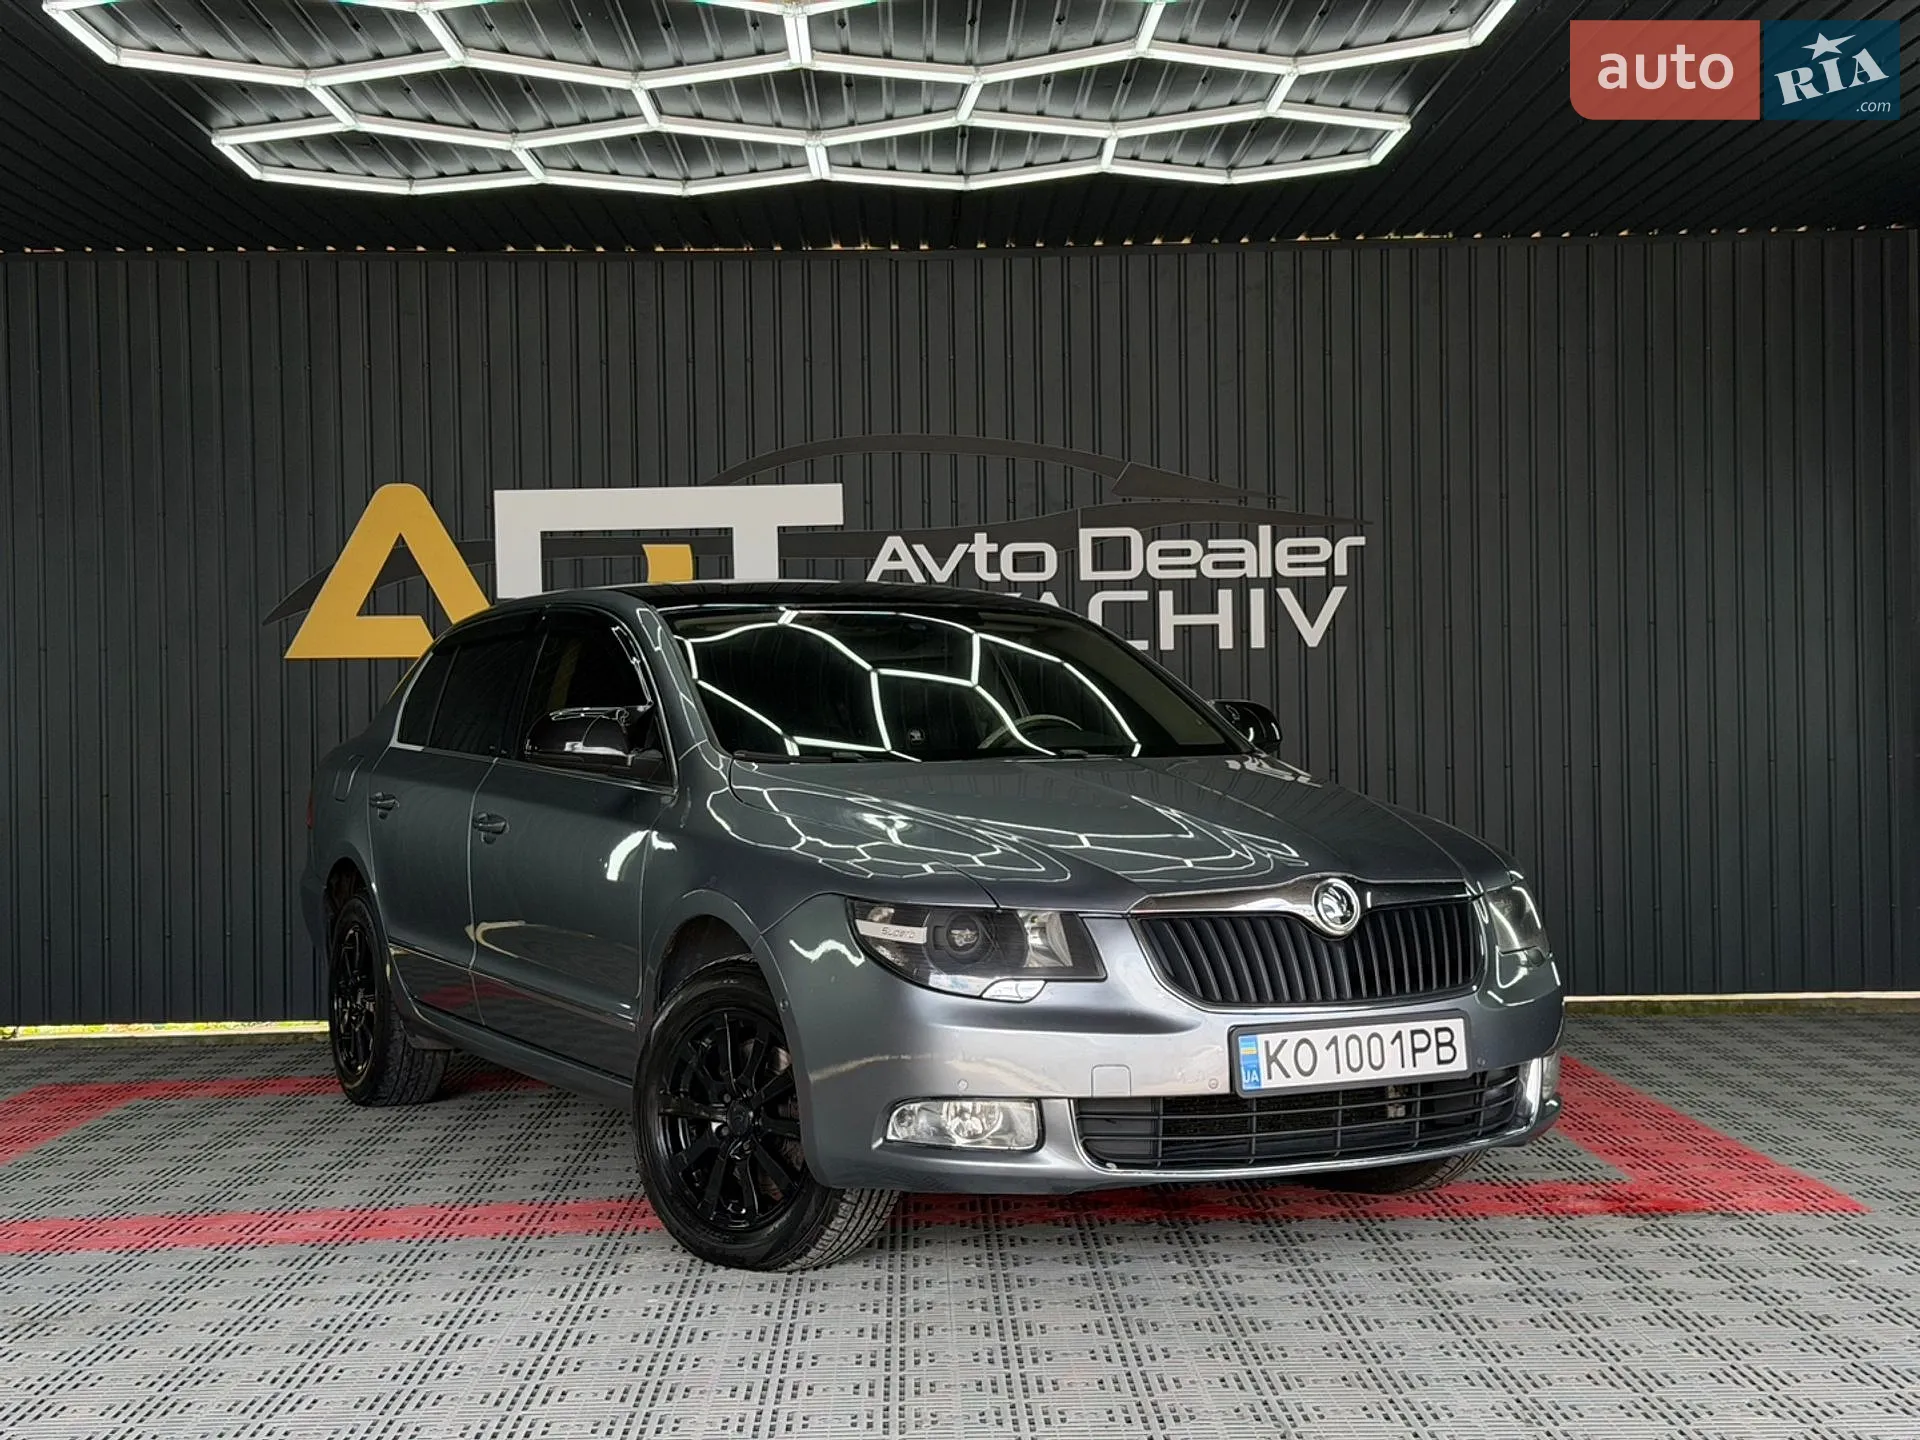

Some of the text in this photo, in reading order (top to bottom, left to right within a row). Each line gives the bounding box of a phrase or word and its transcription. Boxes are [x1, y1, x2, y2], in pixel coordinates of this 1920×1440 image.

[866, 525, 1366, 583] Avto Dealer
[1001, 586, 1347, 650] CHIV
[1242, 1069, 1260, 1083] UA
